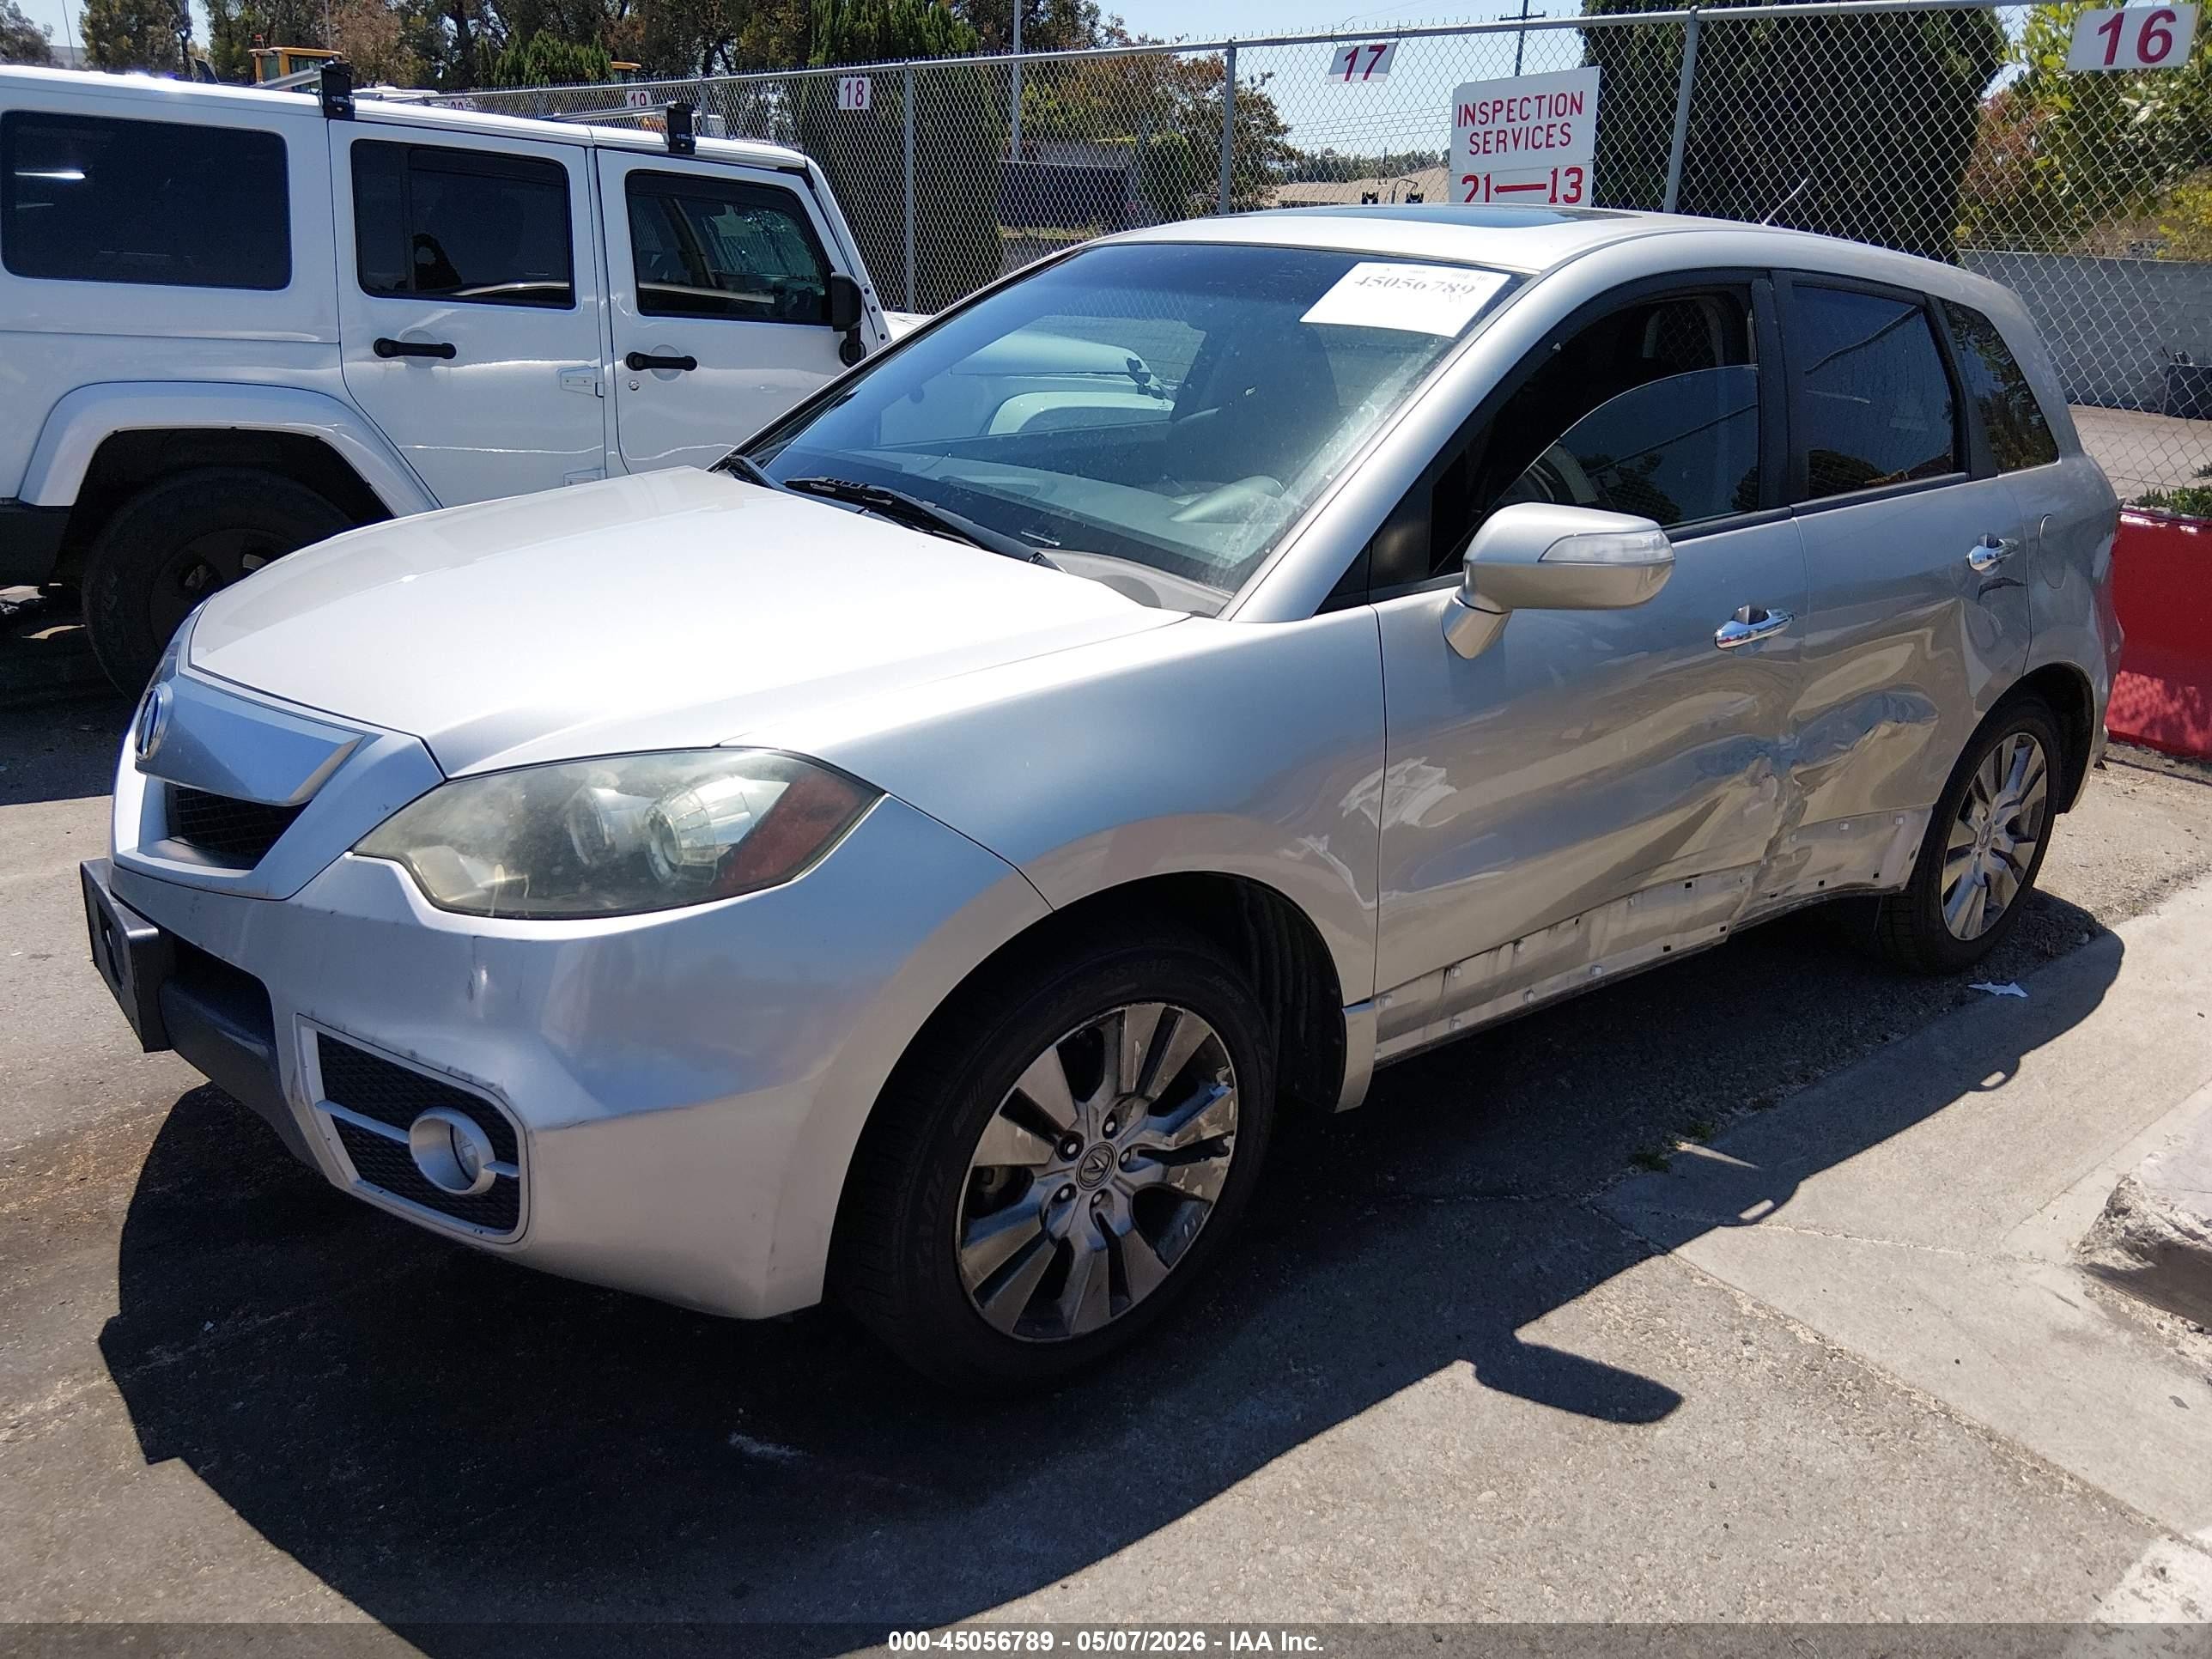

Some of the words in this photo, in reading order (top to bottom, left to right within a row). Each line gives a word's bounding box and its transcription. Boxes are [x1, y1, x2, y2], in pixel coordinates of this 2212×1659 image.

[2097, 9, 2177, 65] 16
[1344, 44, 1388, 82] 17
[844, 80, 865, 108] 18
[1457, 90, 1584, 128] INSPECTION
[1468, 122, 1572, 155] SERVICES
[1462, 173, 1491, 204] 21
[1548, 167, 1584, 204] 13
[1353, 275, 1477, 295] 45056789
